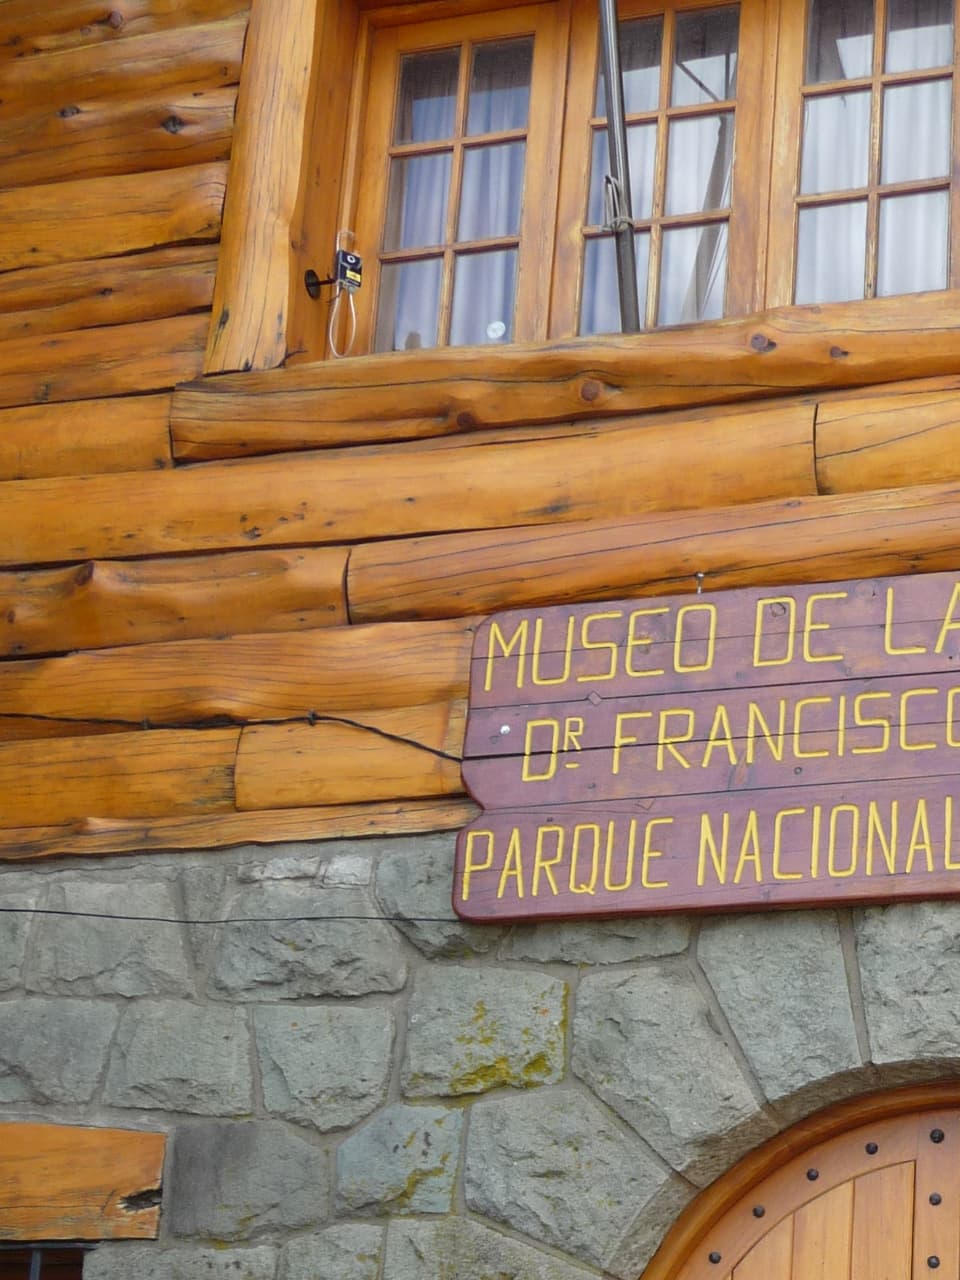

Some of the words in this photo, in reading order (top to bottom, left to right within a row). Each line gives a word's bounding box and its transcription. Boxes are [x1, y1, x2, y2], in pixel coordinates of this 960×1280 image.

[483, 603, 717, 692] MUSEO
[752, 591, 849, 667] DE
[461, 816, 675, 902] PARQUE
